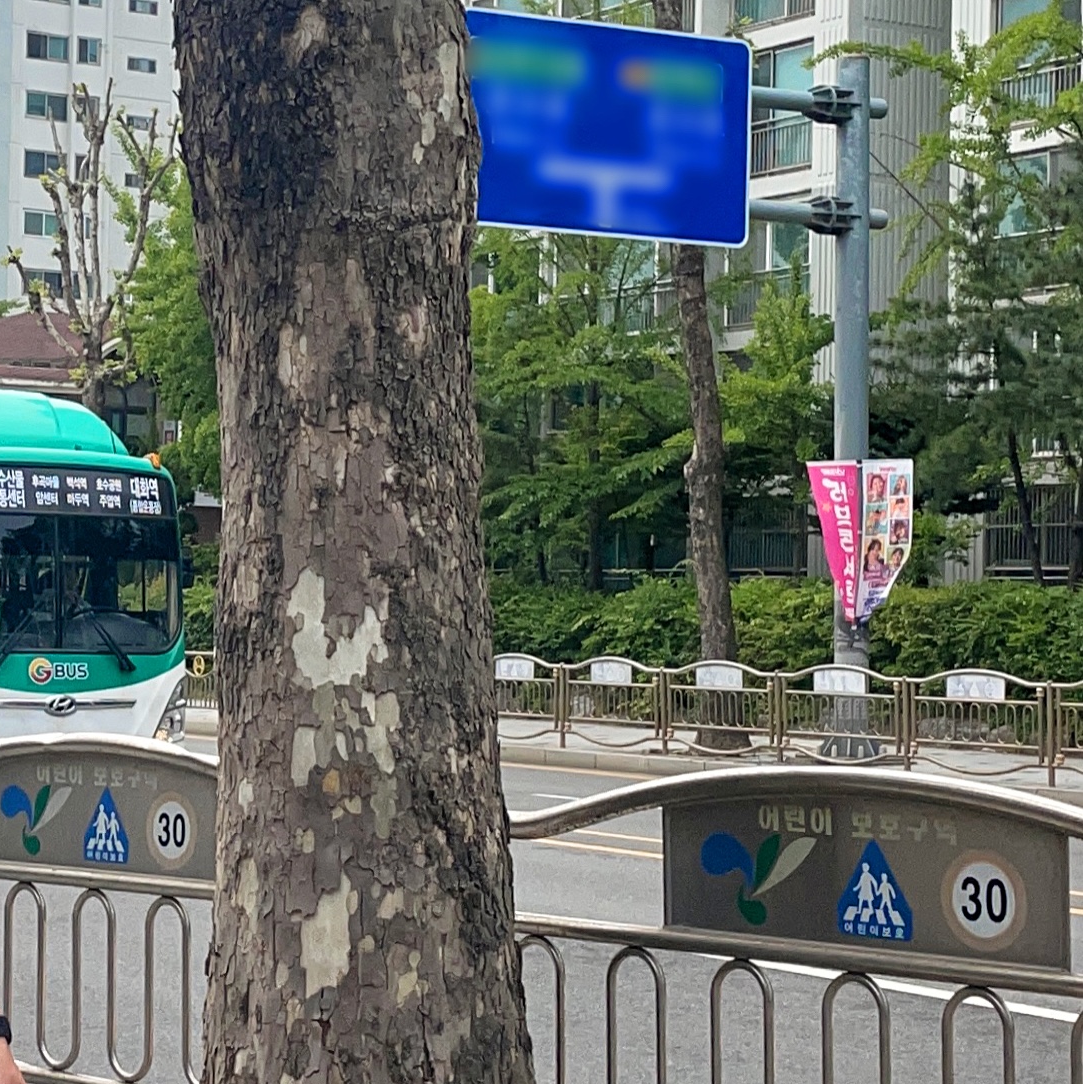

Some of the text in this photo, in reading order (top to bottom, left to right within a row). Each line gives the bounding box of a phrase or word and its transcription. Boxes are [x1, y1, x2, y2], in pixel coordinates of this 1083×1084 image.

[31, 474, 60, 490] 후곡마을
[66, 476, 87, 491] 백석역
[95, 477, 123, 493] 호수공원
[129, 477, 160, 500] 대화역
[35, 491, 59, 506] 암센터
[66, 492, 90, 507] 마두역
[36, 764, 83, 786] 어린이
[758, 804, 833, 836] 어린이
[158, 812, 186, 848] 30
[961, 876, 1007, 923] 30
[843, 921, 905, 939] 어린이보호
